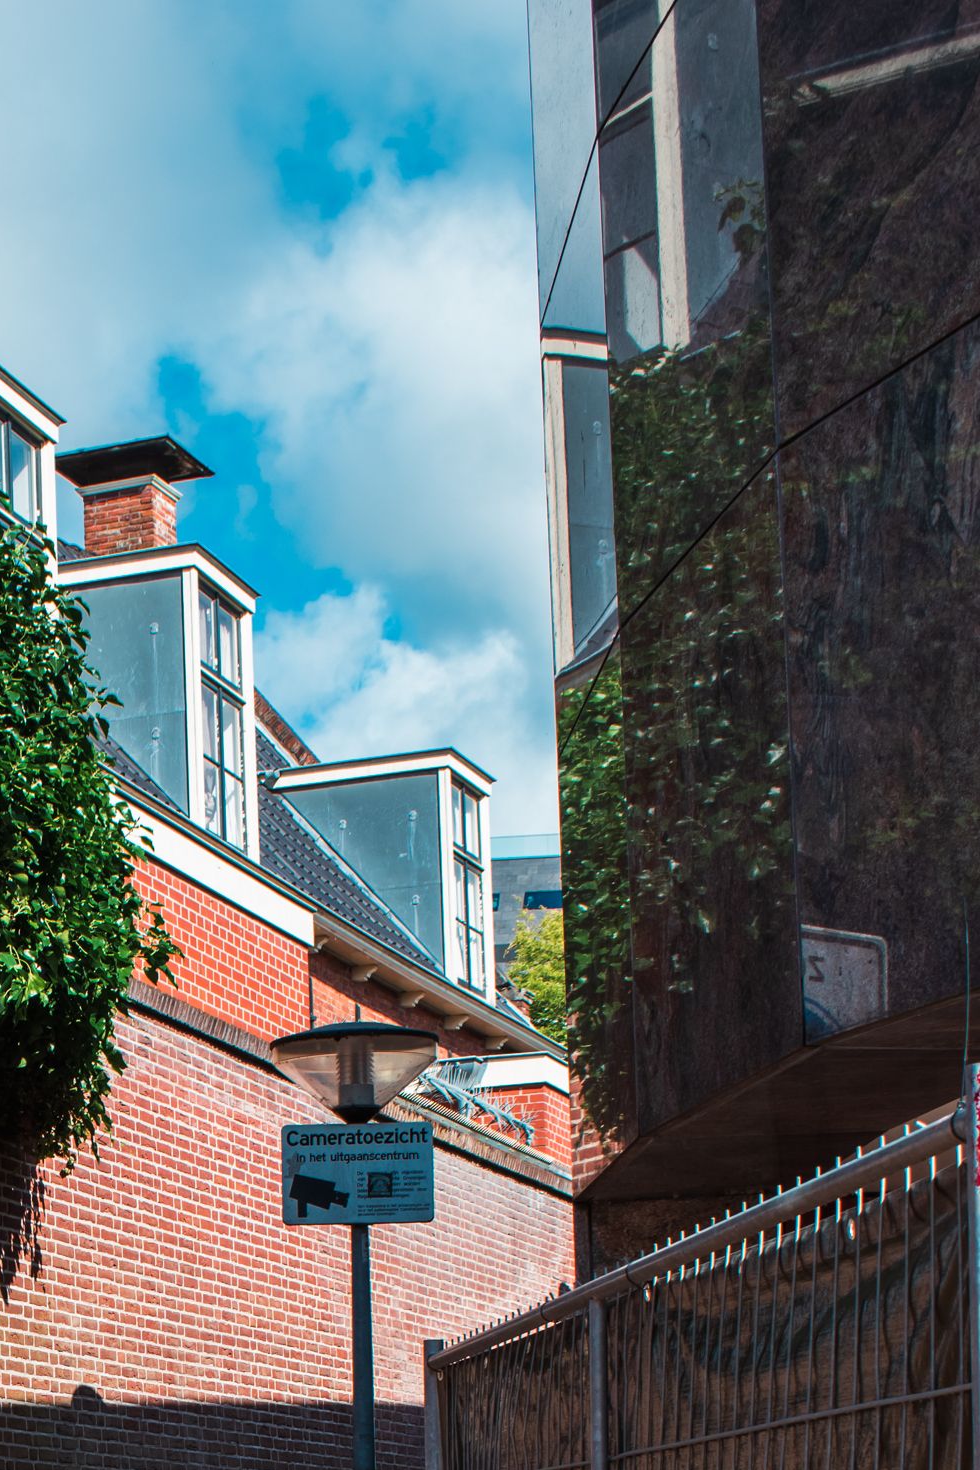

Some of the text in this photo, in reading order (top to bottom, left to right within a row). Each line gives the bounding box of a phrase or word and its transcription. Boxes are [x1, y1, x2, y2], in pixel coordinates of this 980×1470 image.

[286, 1128, 428, 1146] Cameratoezicht
[309, 1152, 326, 1163] het
[330, 1151, 420, 1164] uitgaanscentrum
